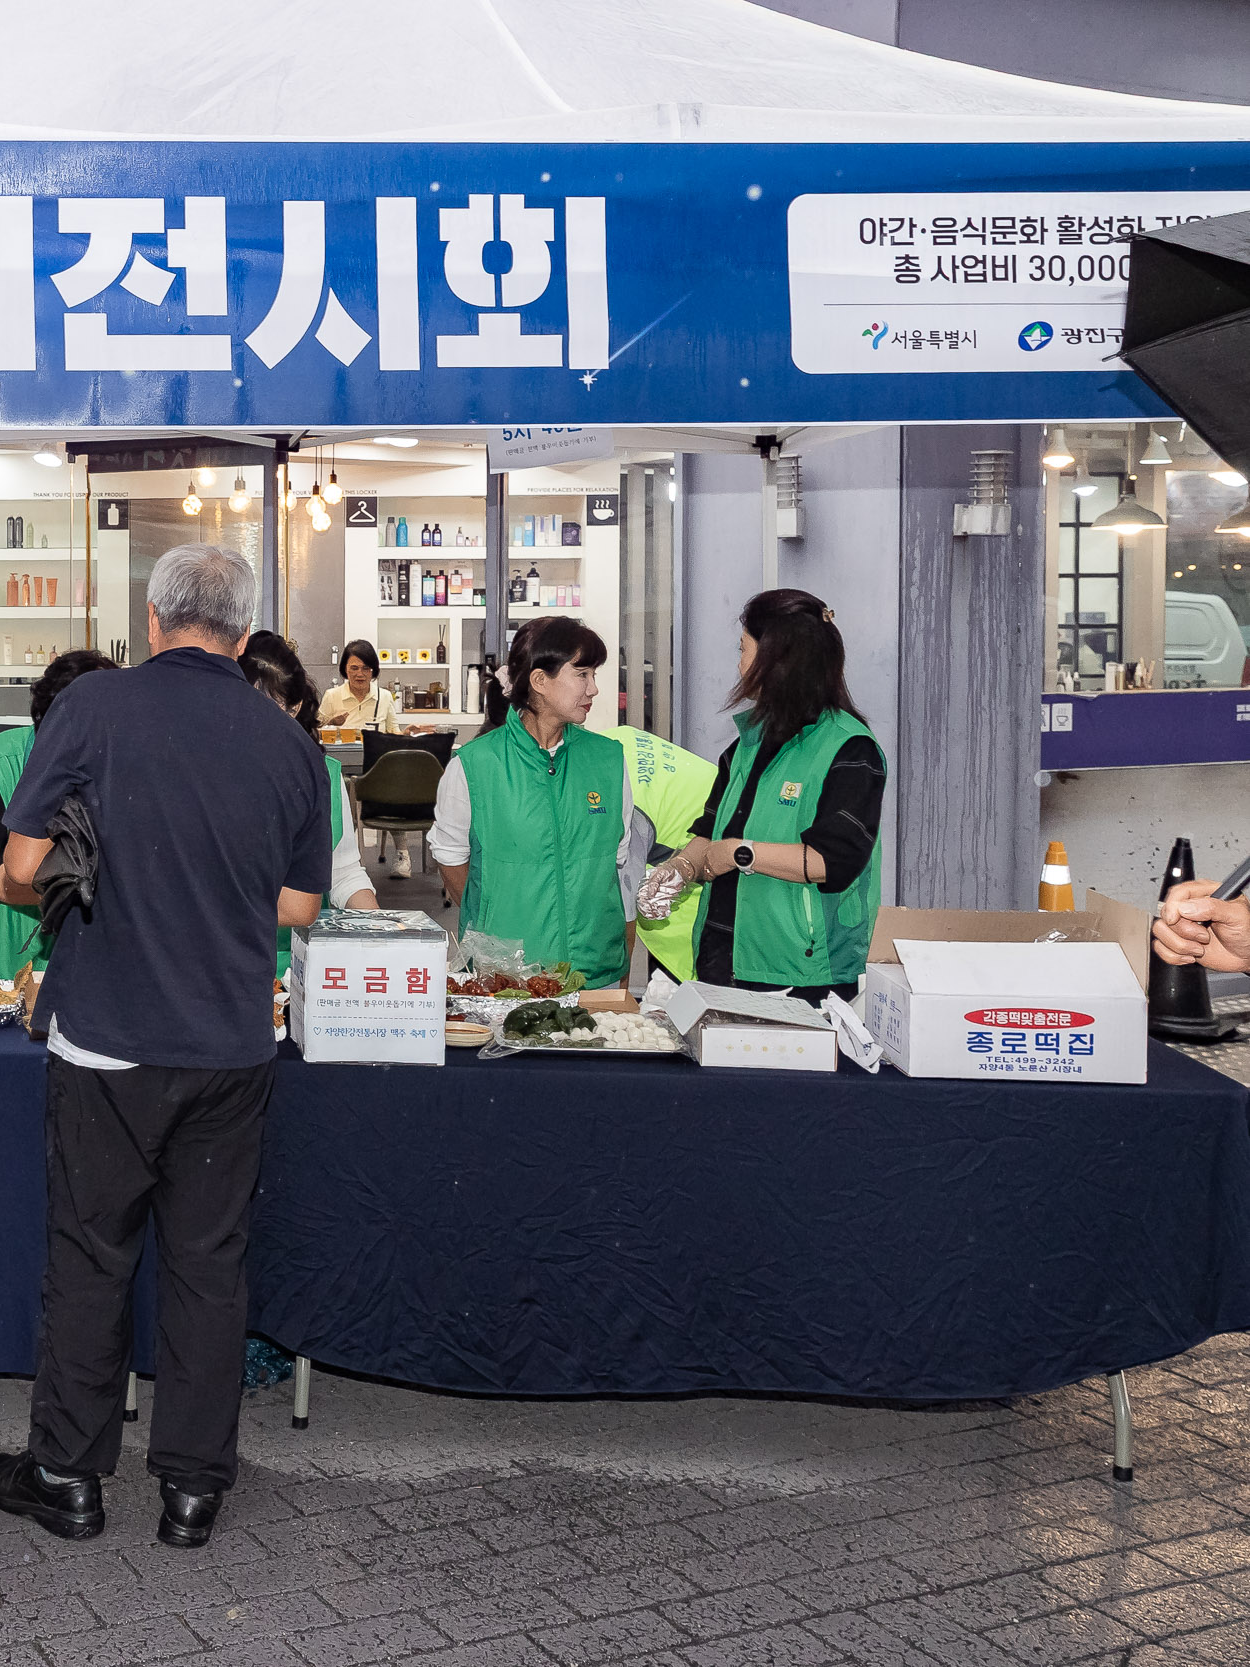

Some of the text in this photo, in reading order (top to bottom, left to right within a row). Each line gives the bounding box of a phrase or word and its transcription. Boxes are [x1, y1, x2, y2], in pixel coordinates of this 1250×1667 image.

[858, 215, 1049, 247] 야간·음식문화
[893, 254, 922, 284] 총
[930, 254, 1018, 284] 사업비
[891, 330, 978, 350] 서울특별시
[316, 999, 341, 1008] (판매금
[345, 999, 360, 1008] 전액
[982, 1011, 1072, 1026] 각종떡맞춤전문
[324, 1027, 426, 1039] 자양한강전통시장 맥주 축제
[965, 1031, 1095, 1056] 종로떡집
[985, 1056, 1075, 1066] TEL:499-3242
[978, 1064, 1014, 1073] 자양4동
[1052, 1065, 1083, 1074] 시장내
